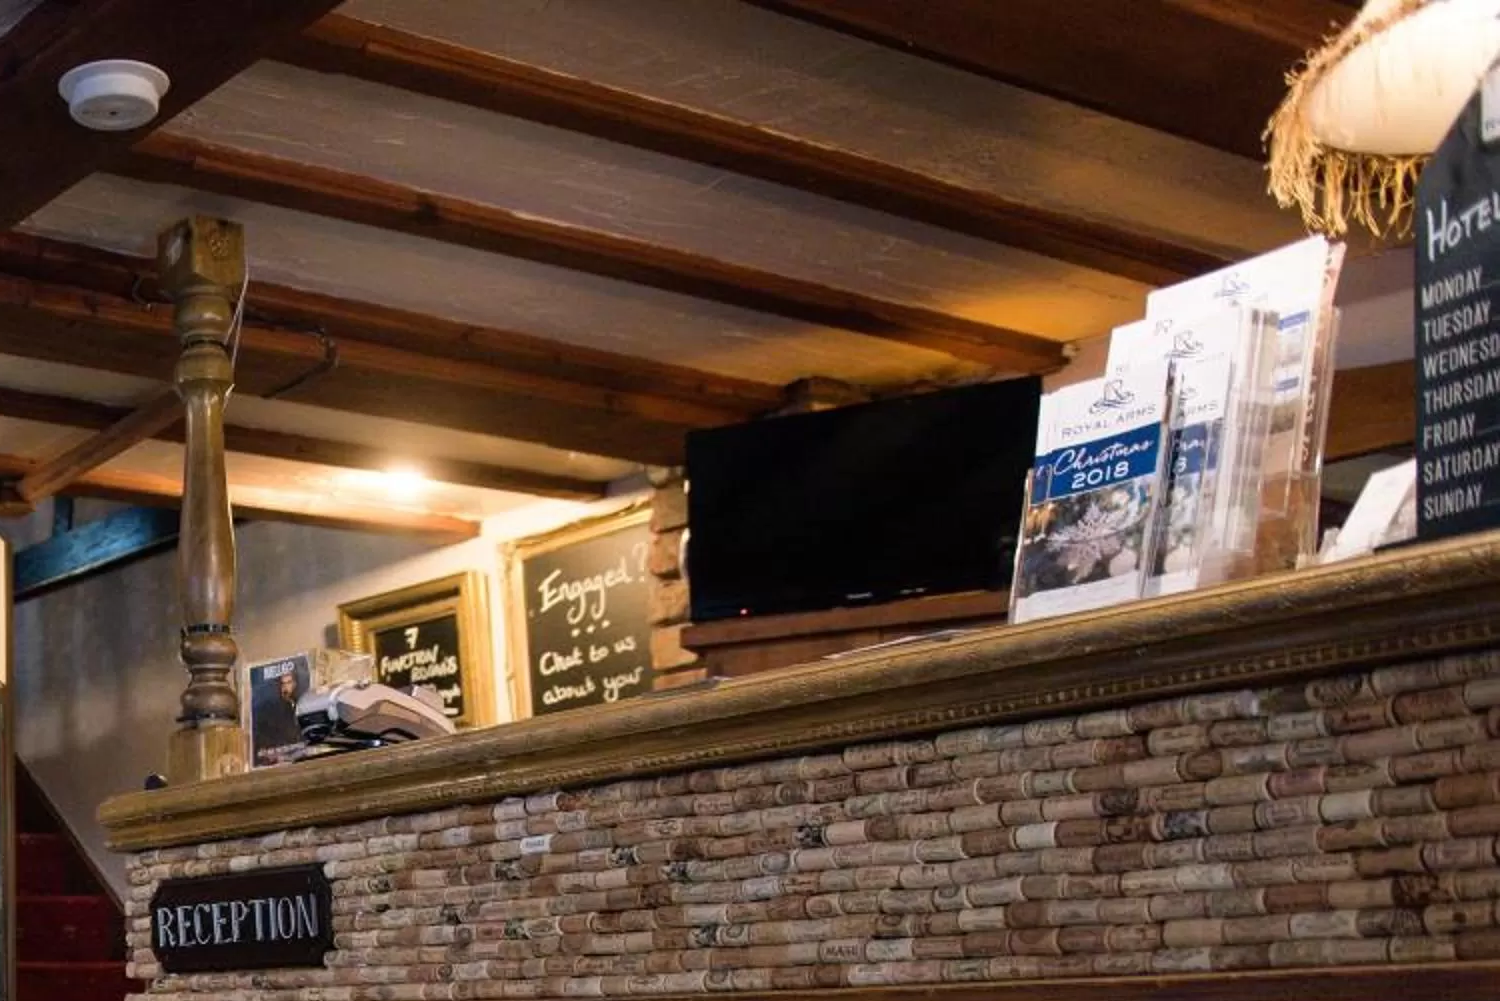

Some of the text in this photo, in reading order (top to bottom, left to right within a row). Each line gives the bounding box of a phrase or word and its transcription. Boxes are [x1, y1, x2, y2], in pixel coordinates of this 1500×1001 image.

[1421, 264, 1482, 311] MONDAY
[1423, 299, 1491, 345] TUESDAY
[1423, 371, 1500, 415] THURSDAY
[1061, 403, 1157, 439] ROYAL ARMS
[1423, 411, 1476, 452] FRIDAY
[1053, 439, 1155, 476] Christmas
[1071, 460, 1130, 490] 2018
[1423, 442, 1500, 486] SATURDAY
[1423, 483, 1483, 521] SUNDAY
[539, 635, 637, 677] Chat to us
[542, 666, 645, 705] about your
[155, 893, 320, 949] RECEPTION
